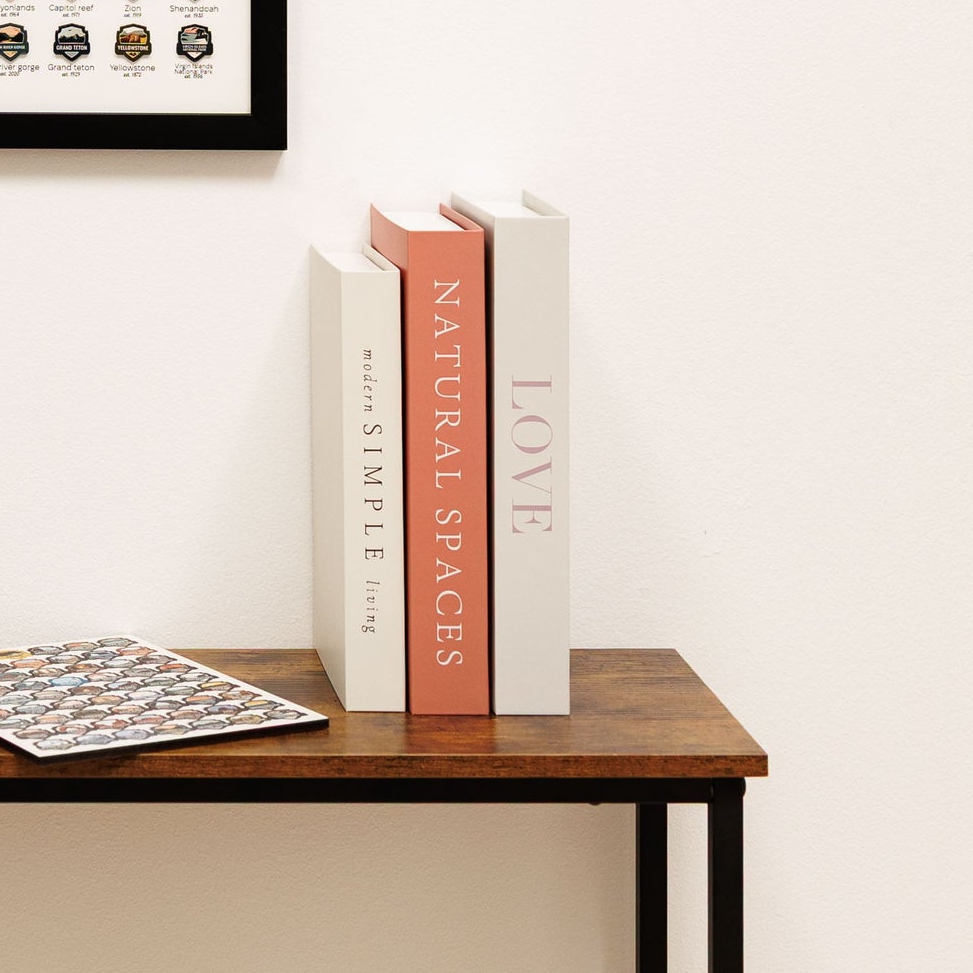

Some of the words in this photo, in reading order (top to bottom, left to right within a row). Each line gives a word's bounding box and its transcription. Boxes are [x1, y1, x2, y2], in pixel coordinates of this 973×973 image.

[362, 349, 378, 412] modern
[434, 279, 462, 489] NATURAL
[363, 424, 384, 560] SIMPLE
[510, 375, 554, 535] LOVE
[361, 580, 380, 633] living
[435, 508, 463, 666] SPACES
